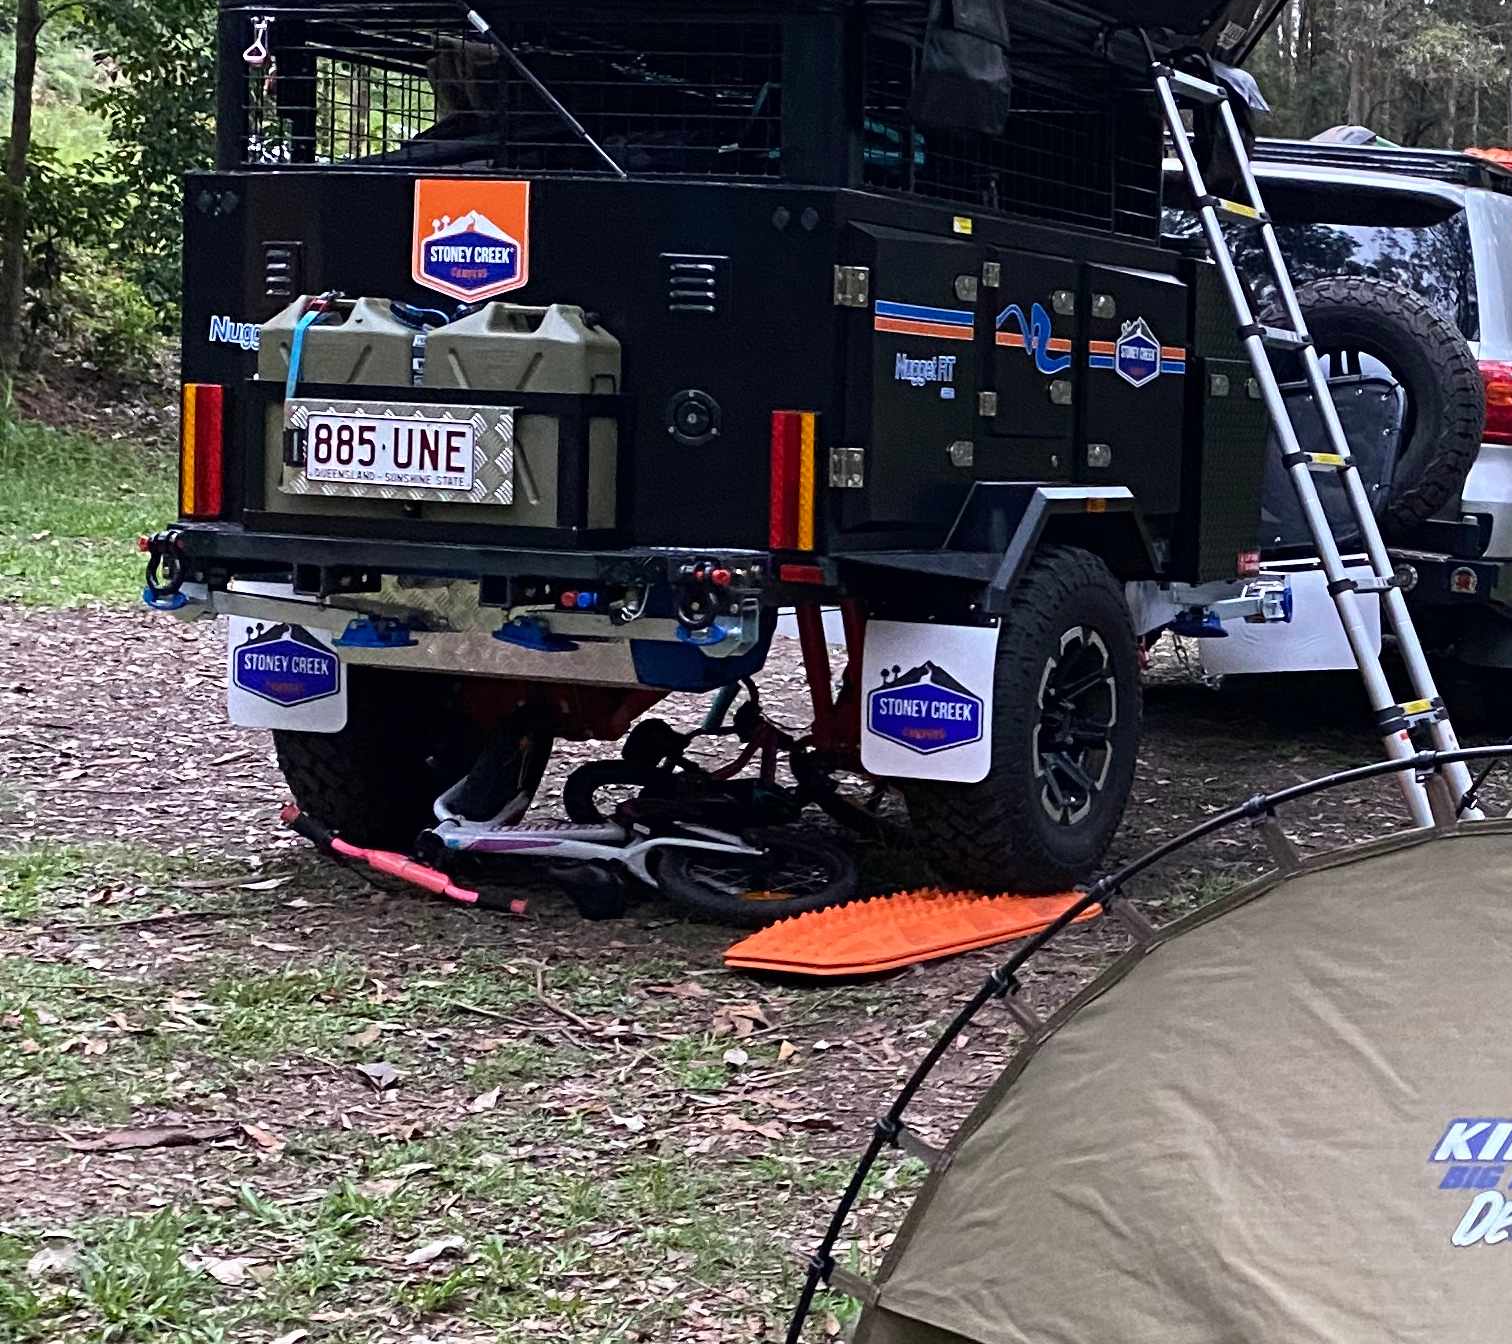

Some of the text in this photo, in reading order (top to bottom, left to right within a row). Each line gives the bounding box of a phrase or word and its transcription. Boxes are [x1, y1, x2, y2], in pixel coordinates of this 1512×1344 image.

[430, 245, 510, 264] STONEY CREEK
[208, 314, 261, 351] Nugg
[895, 352, 937, 387] Nugget
[314, 423, 467, 474] 885 UNE
[313, 467, 466, 488] QUEENSLAND SUNSHINE STATE
[243, 653, 329, 676] STONEY CREEK
[879, 697, 972, 722] STONEY CREEK
[1438, 1165, 1506, 1191] BIG
